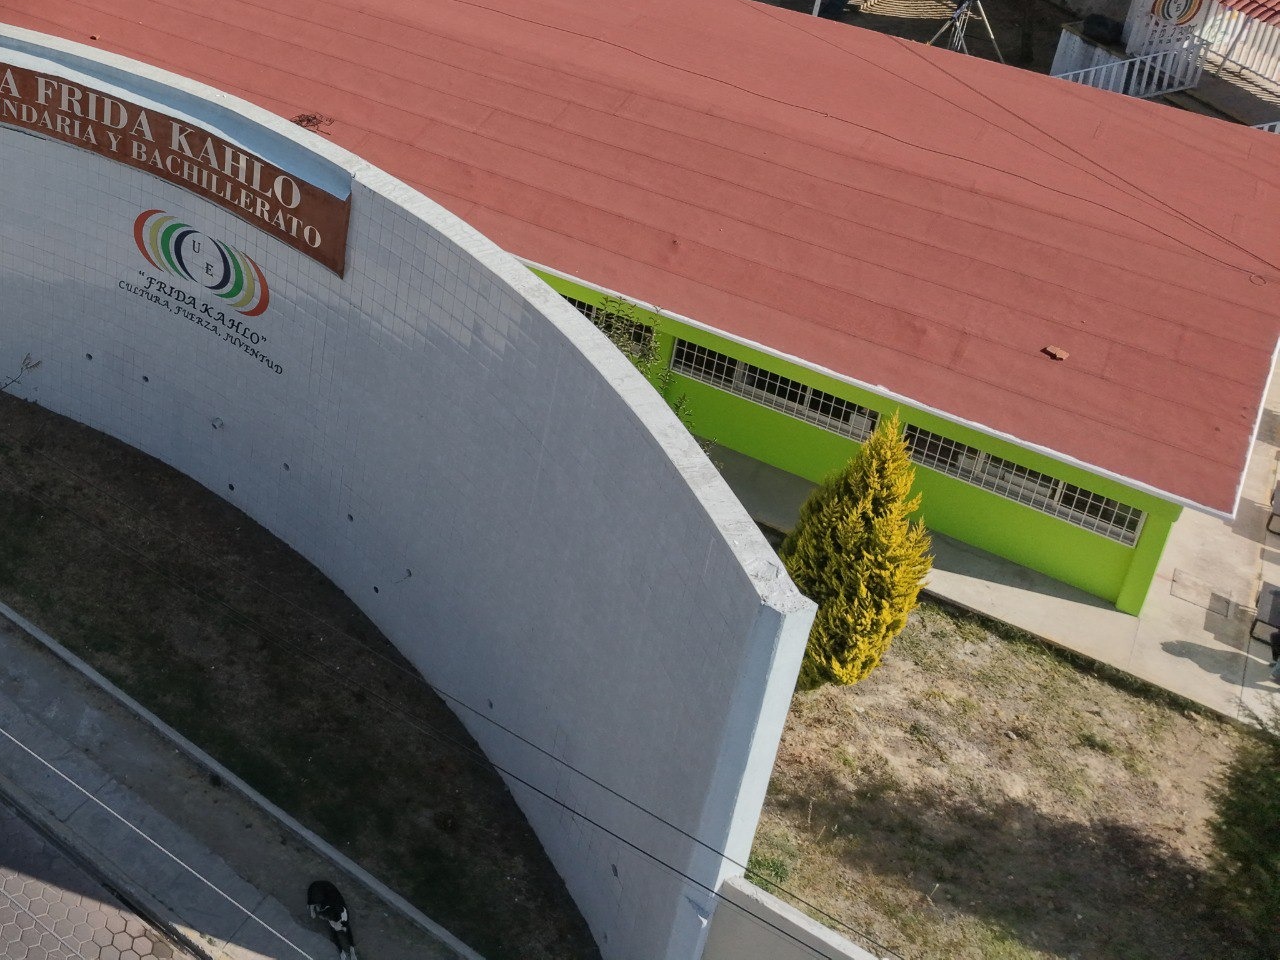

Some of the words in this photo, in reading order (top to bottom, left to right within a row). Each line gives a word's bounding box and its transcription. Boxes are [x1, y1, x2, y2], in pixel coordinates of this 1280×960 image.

[35, 76, 155, 143] FRIDA
[169, 120, 301, 209] KAHLO
[106, 130, 122, 152] Y
[131, 140, 322, 248] BACHILLERATO
[192, 240, 201, 253] U
[204, 262, 214, 277] E
[118, 280, 172, 313] CULTURA,
[174, 305, 221, 336] FUERZA,
[223, 332, 284, 375] JUVENTUD
